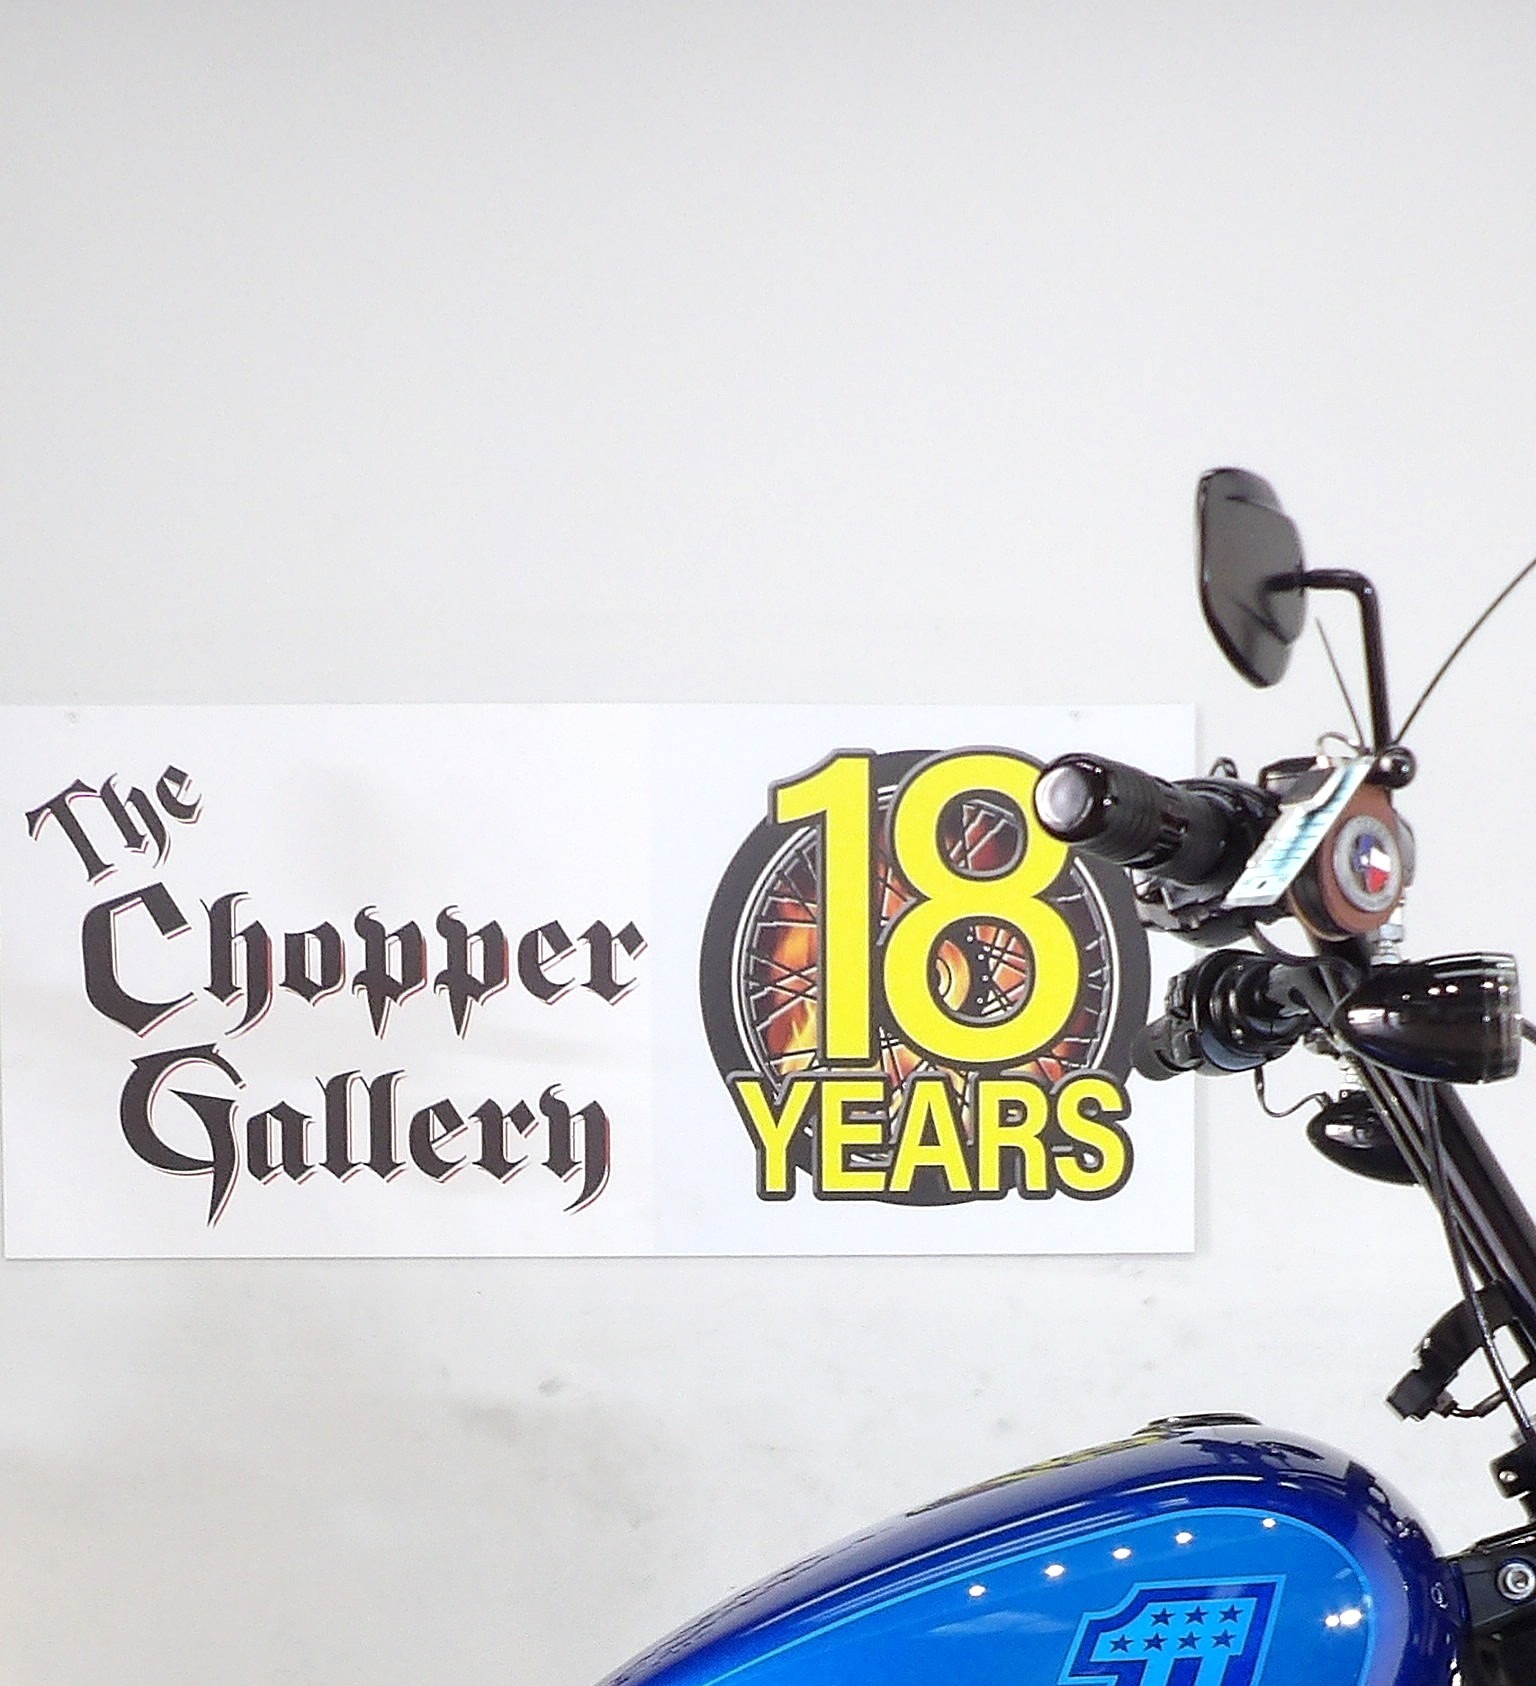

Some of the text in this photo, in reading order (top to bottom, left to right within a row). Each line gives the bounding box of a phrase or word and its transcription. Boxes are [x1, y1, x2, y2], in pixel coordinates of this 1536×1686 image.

[26, 763, 204, 884] The
[80, 880, 649, 1041] Chopper
[767, 746, 1088, 1070] 18
[118, 1042, 612, 1229] Gallery
[731, 1073, 1135, 1202] YEARS
